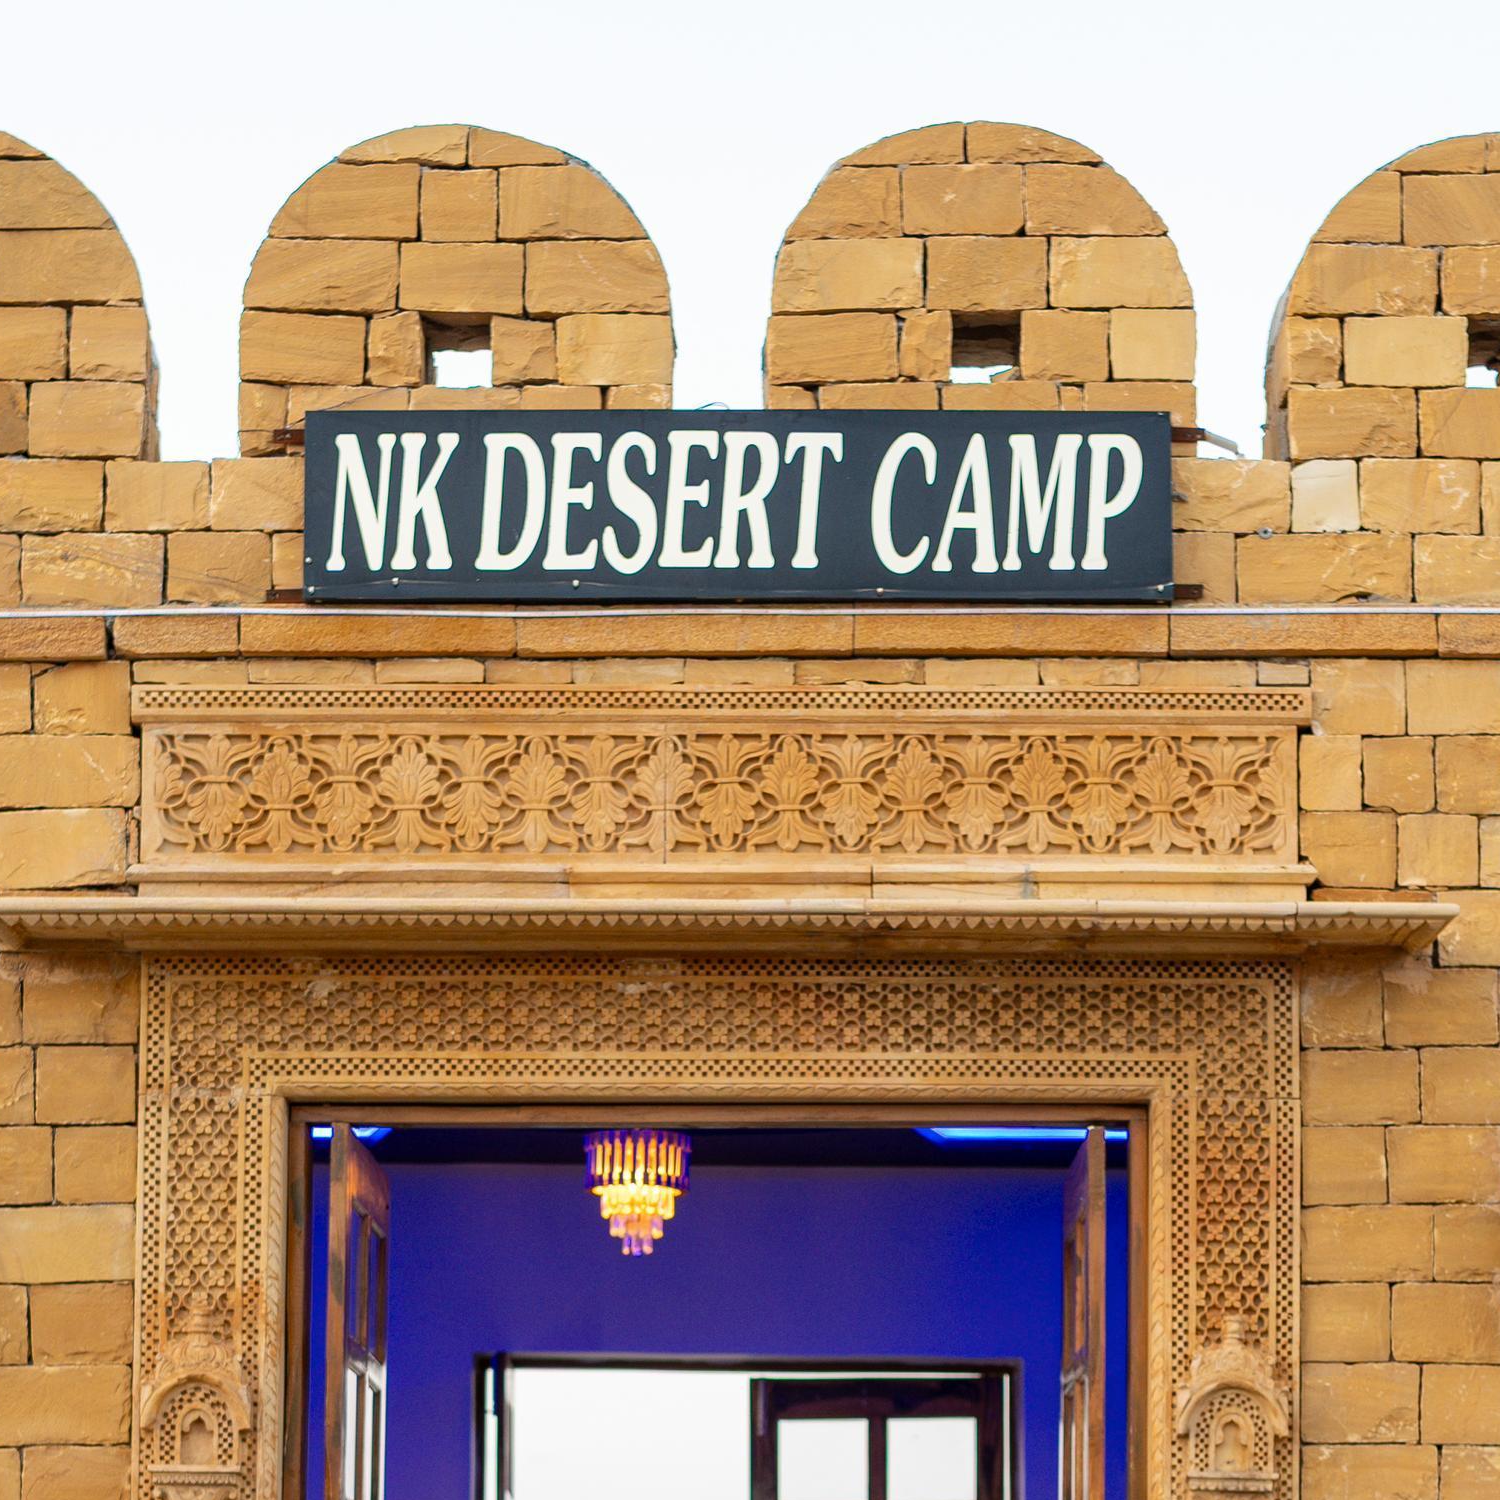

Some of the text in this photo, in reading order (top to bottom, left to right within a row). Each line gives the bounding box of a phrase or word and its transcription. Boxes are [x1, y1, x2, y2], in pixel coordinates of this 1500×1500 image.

[326, 430, 1144, 575] NK DESERT CAMP
